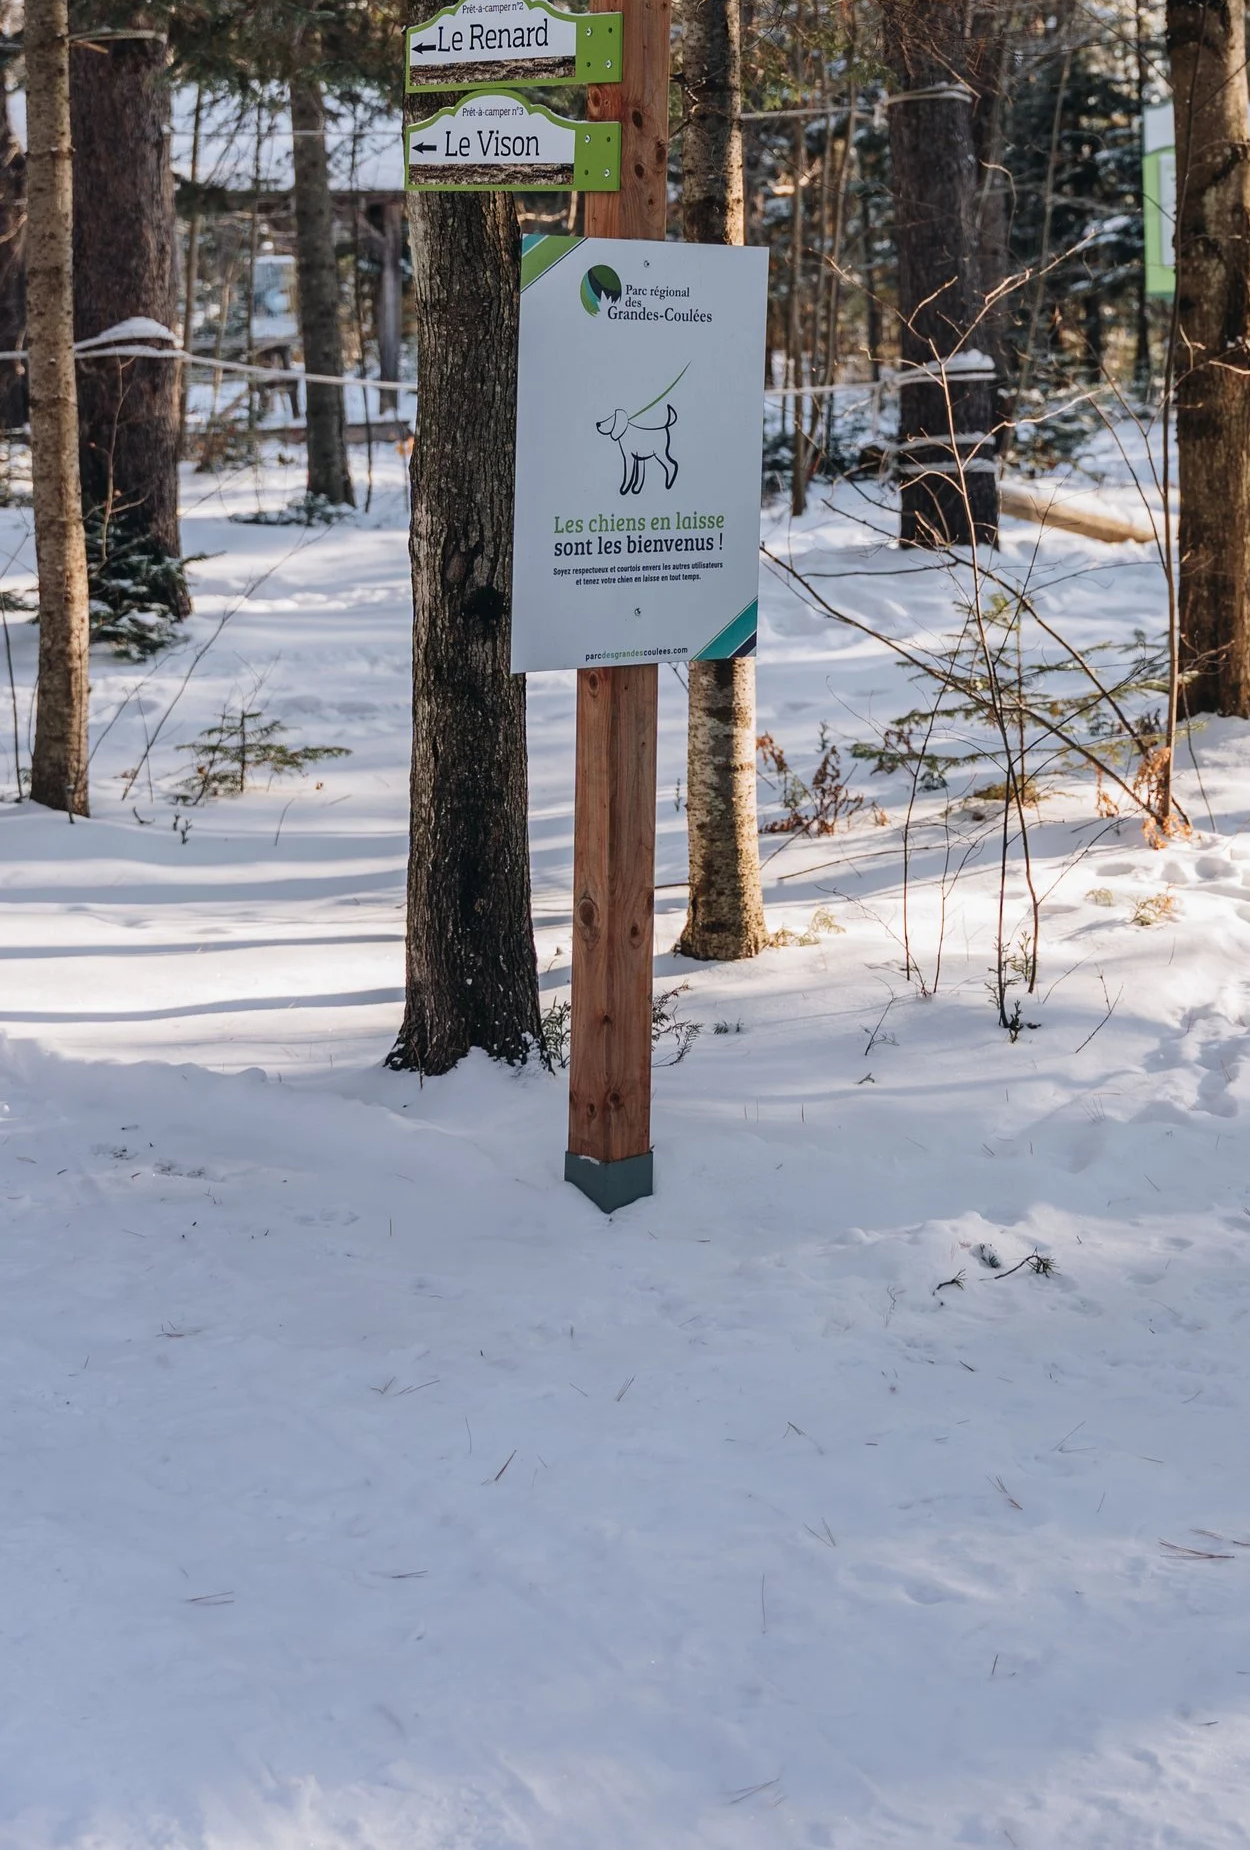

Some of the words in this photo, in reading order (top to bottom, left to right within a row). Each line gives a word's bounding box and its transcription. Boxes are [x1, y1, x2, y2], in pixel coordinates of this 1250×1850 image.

[462, 4, 511, 14] Prêt-à-camper
[438, 26, 463, 52] Le
[469, 18, 549, 50] Renard
[462, 107, 511, 118] Prêt-à-camper
[445, 130, 471, 157] Le
[477, 130, 540, 157] Vison
[625, 284, 647, 296] Parc
[650, 286, 690, 300] régional
[625, 297, 642, 308] des
[607, 305, 713, 323] Grandes-Coulées
[554, 516, 584, 534] Les
[588, 513, 646, 533] chiens
[650, 516, 671, 530] en
[675, 511, 725, 530] laisse
[554, 538, 593, 557] sont
[597, 536, 622, 555] les
[627, 535, 714, 554] bienvenus
[553, 567, 571, 576] Soyez
[572, 566, 609, 576] respectueux
[610, 565, 616, 573] et
[617, 564, 641, 572] courtois
[662, 563, 671, 571] les
[672, 562, 690, 570] autres
[691, 561, 723, 569] utilisateurs
[576, 578, 582, 586] et
[583, 577, 600, 585] tenez
[601, 576, 616, 584] votre
[617, 575, 633, 584] chien
[643, 574, 660, 582] laisse
[669, 573, 681, 581] tout
[682, 573, 702, 582] temps.
[585, 647, 688, 661] parcdesgrandescoulees.com
